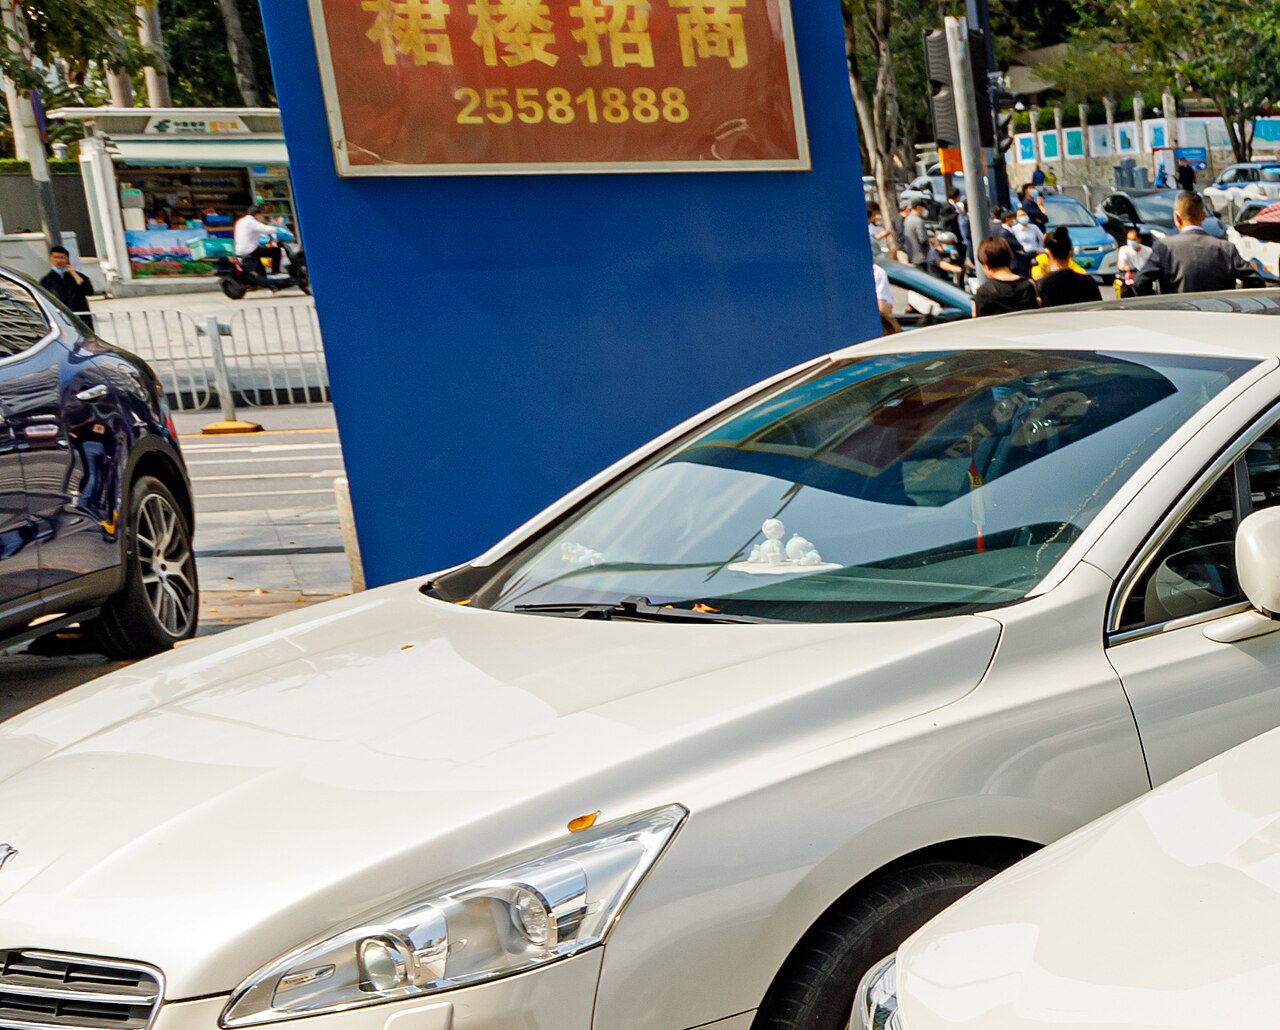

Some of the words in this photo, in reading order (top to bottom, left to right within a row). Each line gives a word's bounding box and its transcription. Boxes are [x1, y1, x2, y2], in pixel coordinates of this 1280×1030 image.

[363, 0, 749, 68] 裙楼招商
[453, 86, 690, 125] 25581888
